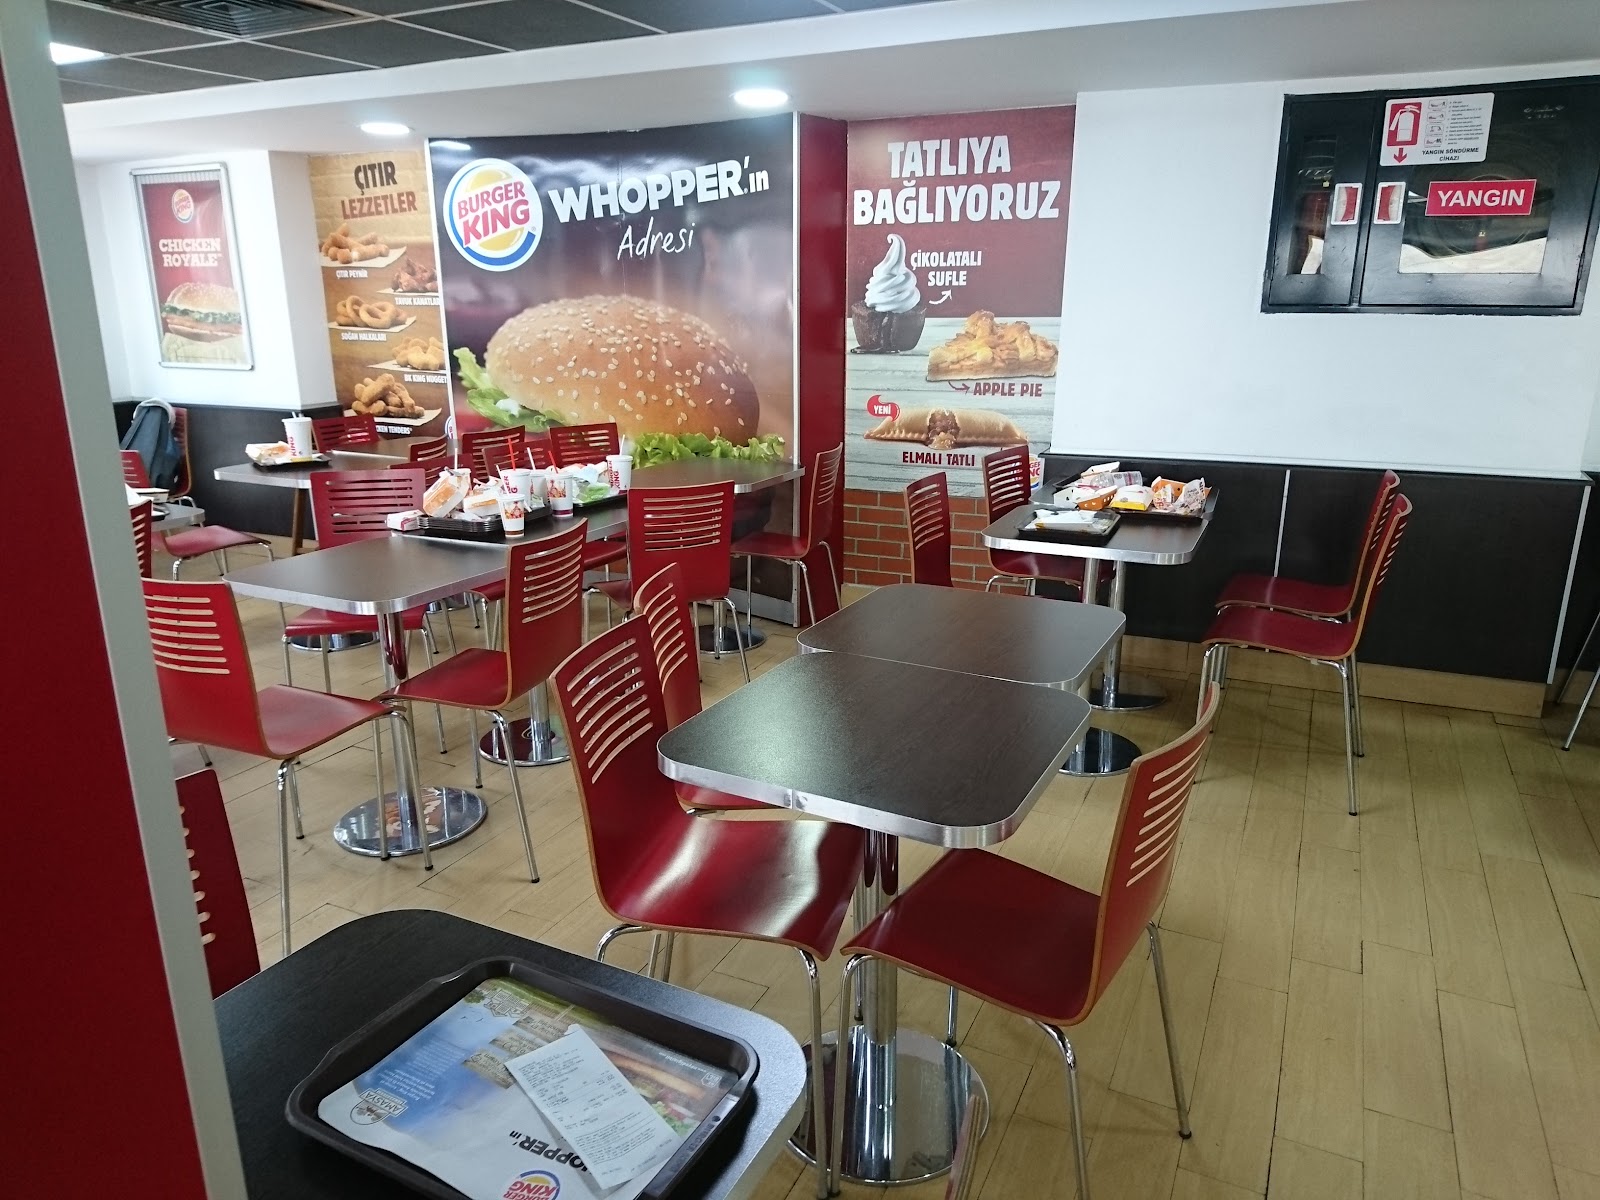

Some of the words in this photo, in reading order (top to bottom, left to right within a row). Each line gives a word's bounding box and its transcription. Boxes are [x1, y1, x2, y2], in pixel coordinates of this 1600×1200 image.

[888, 135, 1011, 179] TATLIYA
[354, 160, 398, 196] ÇITIR
[340, 190, 418, 220] LEZZETLER
[457, 181, 526, 220] BURGER
[853, 180, 1061, 226] BAĞLIYORUZ
[1438, 189, 1526, 207] YANGIN
[462, 198, 531, 247] KING
[158, 238, 221, 252] CHICKEN
[617, 216, 696, 261] Adresi
[910, 249, 982, 271] ÇİKOLATALI
[928, 271, 967, 287] SUFLE
[341, 332, 358, 340] SOĞAN
[413, 374, 426, 383] KING
[973, 382, 1016, 397] APPLE
[1020, 383, 1042, 398] PIE
[873, 404, 892, 415] YENİ
[902, 451, 942, 466] ELMALI
[946, 453, 976, 467] TATLI
[364, 1090, 402, 1112] AMASYA
[508, 1180, 558, 1197] KING
